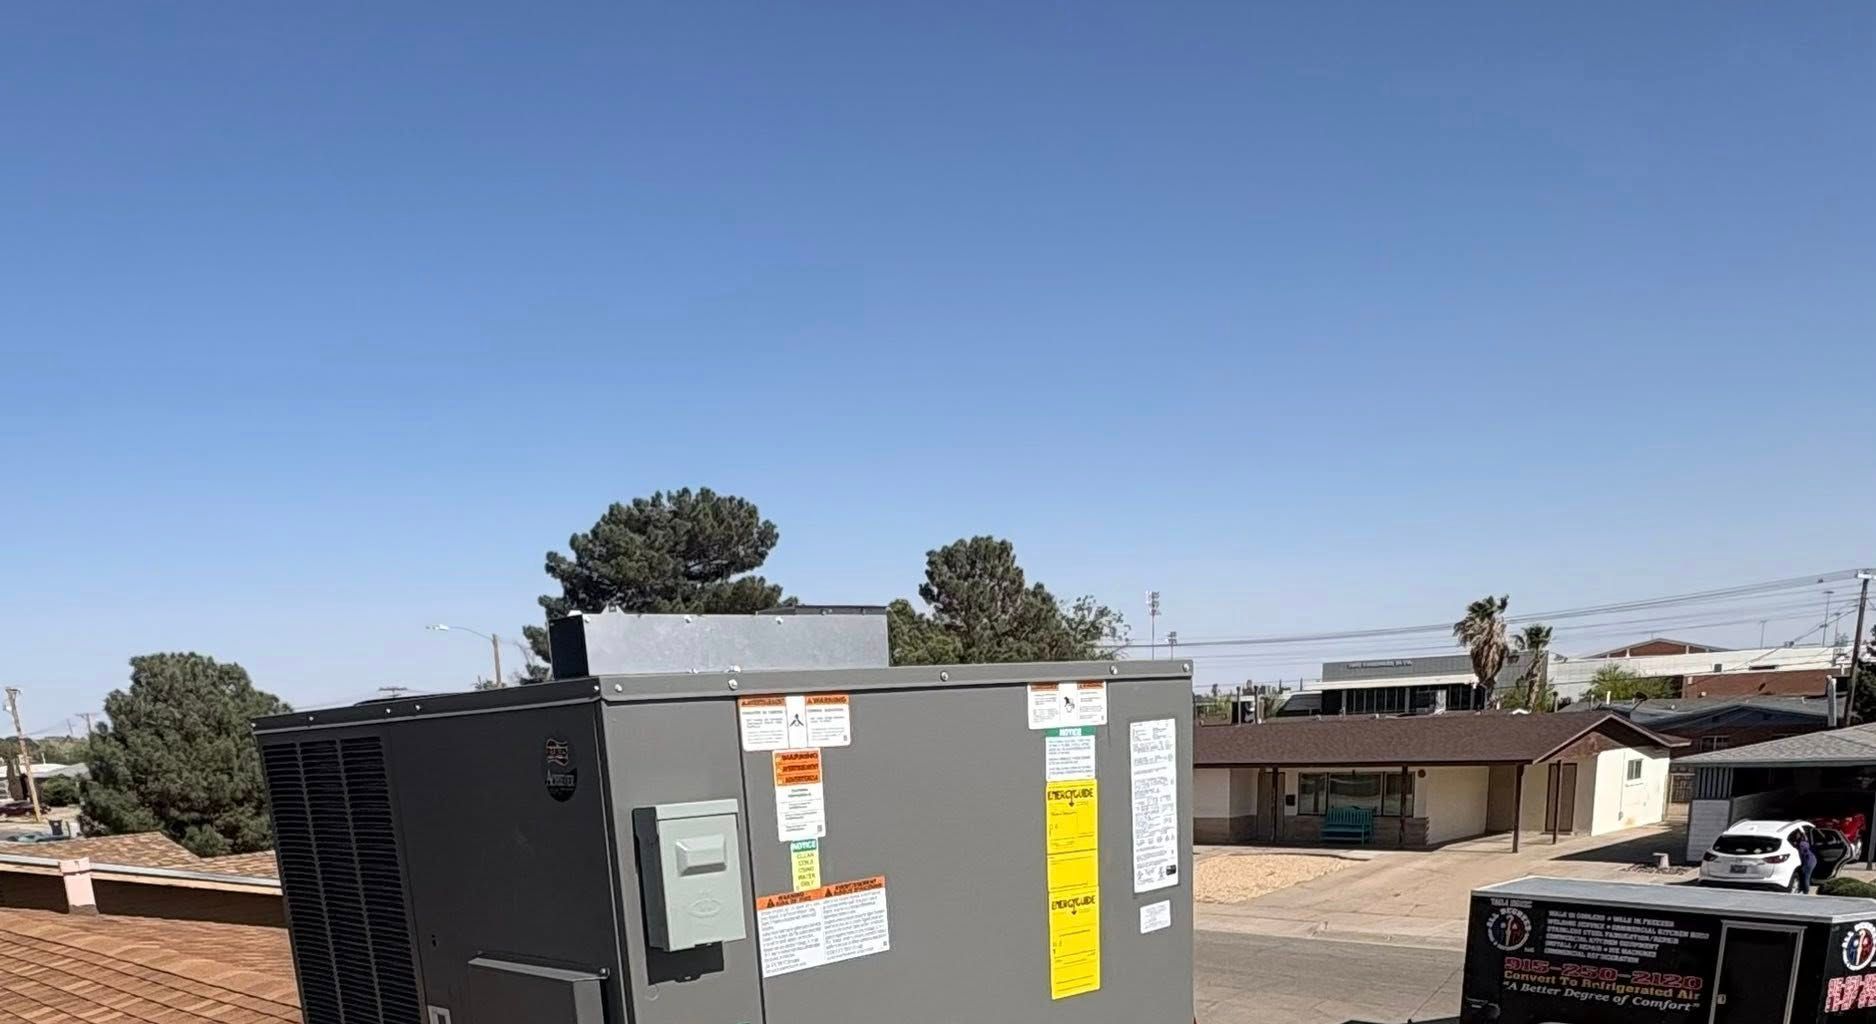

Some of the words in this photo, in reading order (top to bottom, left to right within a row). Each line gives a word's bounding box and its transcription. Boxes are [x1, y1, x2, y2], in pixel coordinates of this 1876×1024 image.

[813, 696, 847, 704] WARNING
[781, 753, 818, 761] WARNING
[792, 839, 817, 850] NOTICE
[1504, 956, 1703, 990] 915-250-2120
[1504, 970, 1556, 984] Convert
[1560, 976, 1578, 987] To
[1678, 989, 1700, 1000] Air
[1521, 982, 1562, 996] Better
[1563, 988, 1610, 1002] Degree
[1613, 994, 1630, 1005] of
